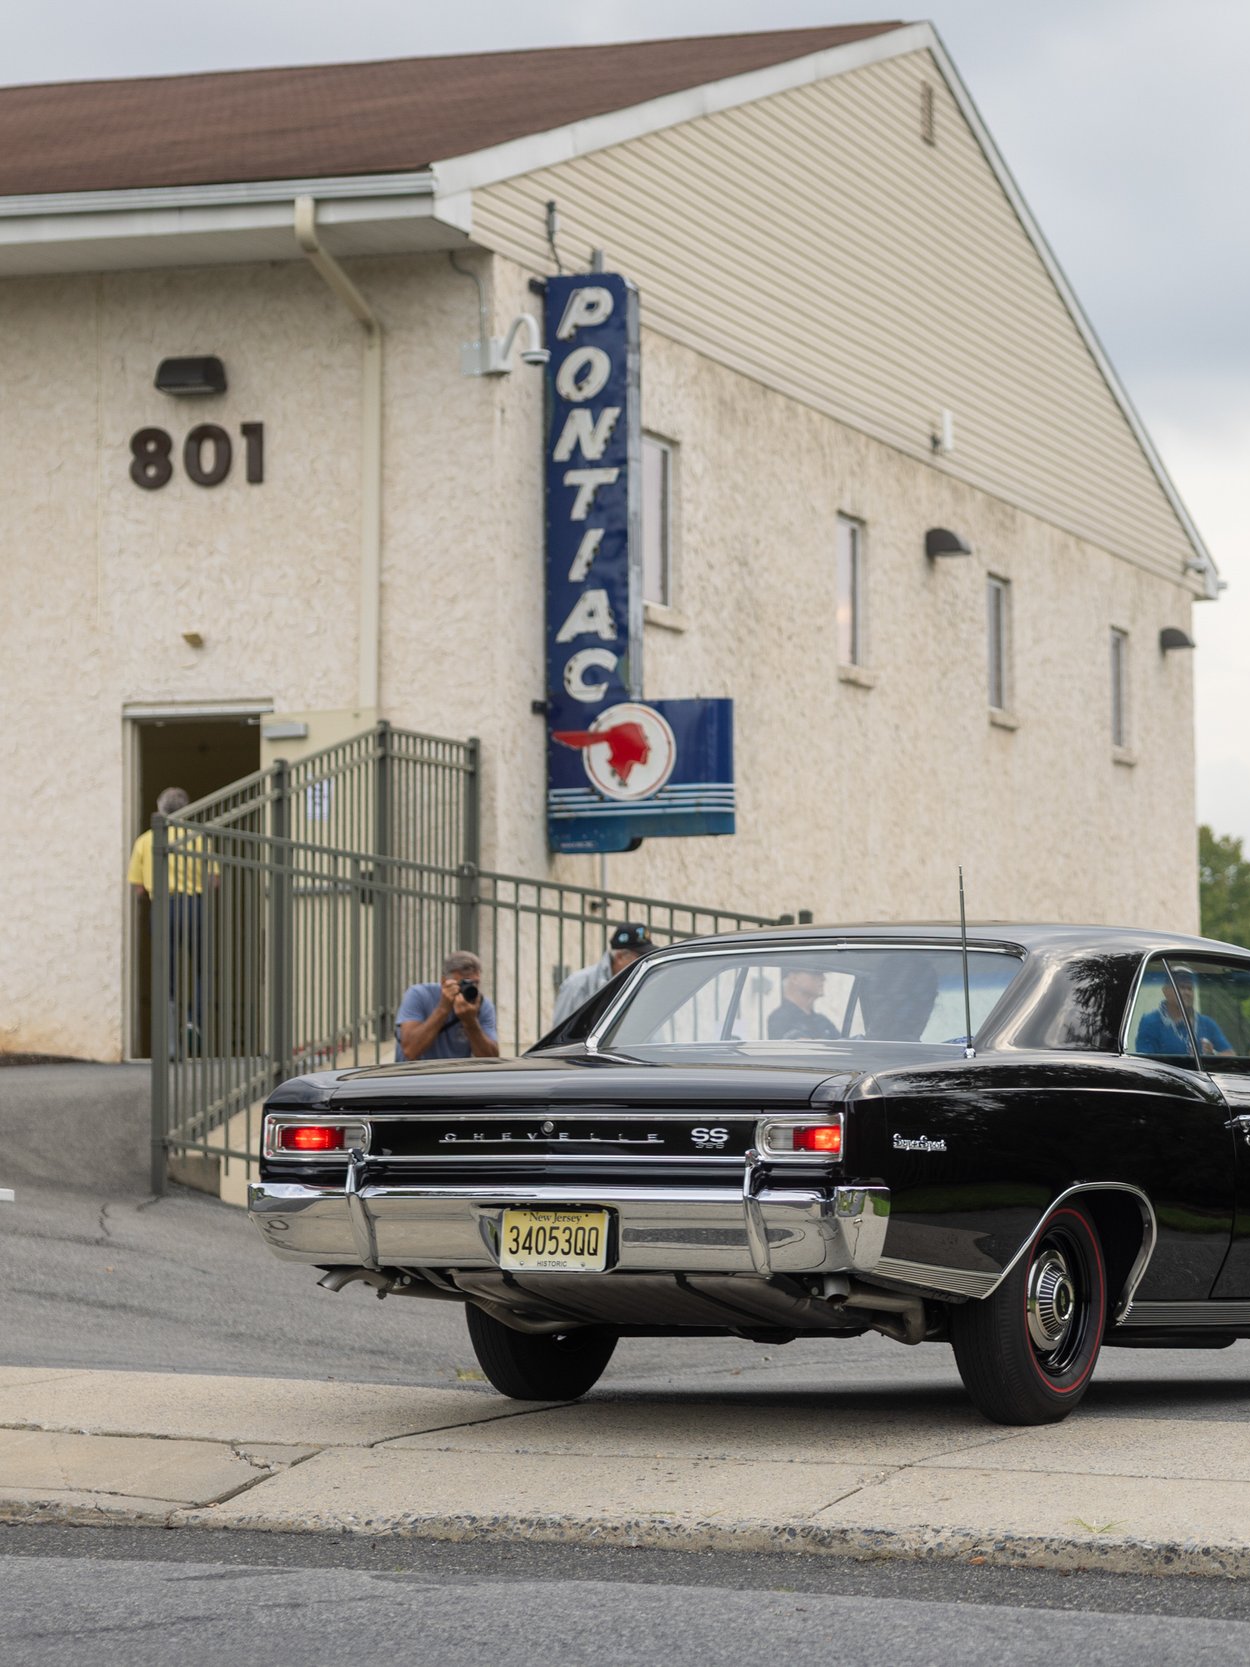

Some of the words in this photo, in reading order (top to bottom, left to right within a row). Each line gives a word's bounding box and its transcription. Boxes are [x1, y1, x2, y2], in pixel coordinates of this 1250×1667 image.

[129, 422, 264, 491] 801
[553, 286, 621, 703] PONTIAC
[444, 1132, 658, 1142] CHEVELLE
[690, 1127, 729, 1142] SS
[529, 1212, 552, 1222] New
[552, 1212, 582, 1224] Jersey
[508, 1225, 600, 1256] 34053QQ
